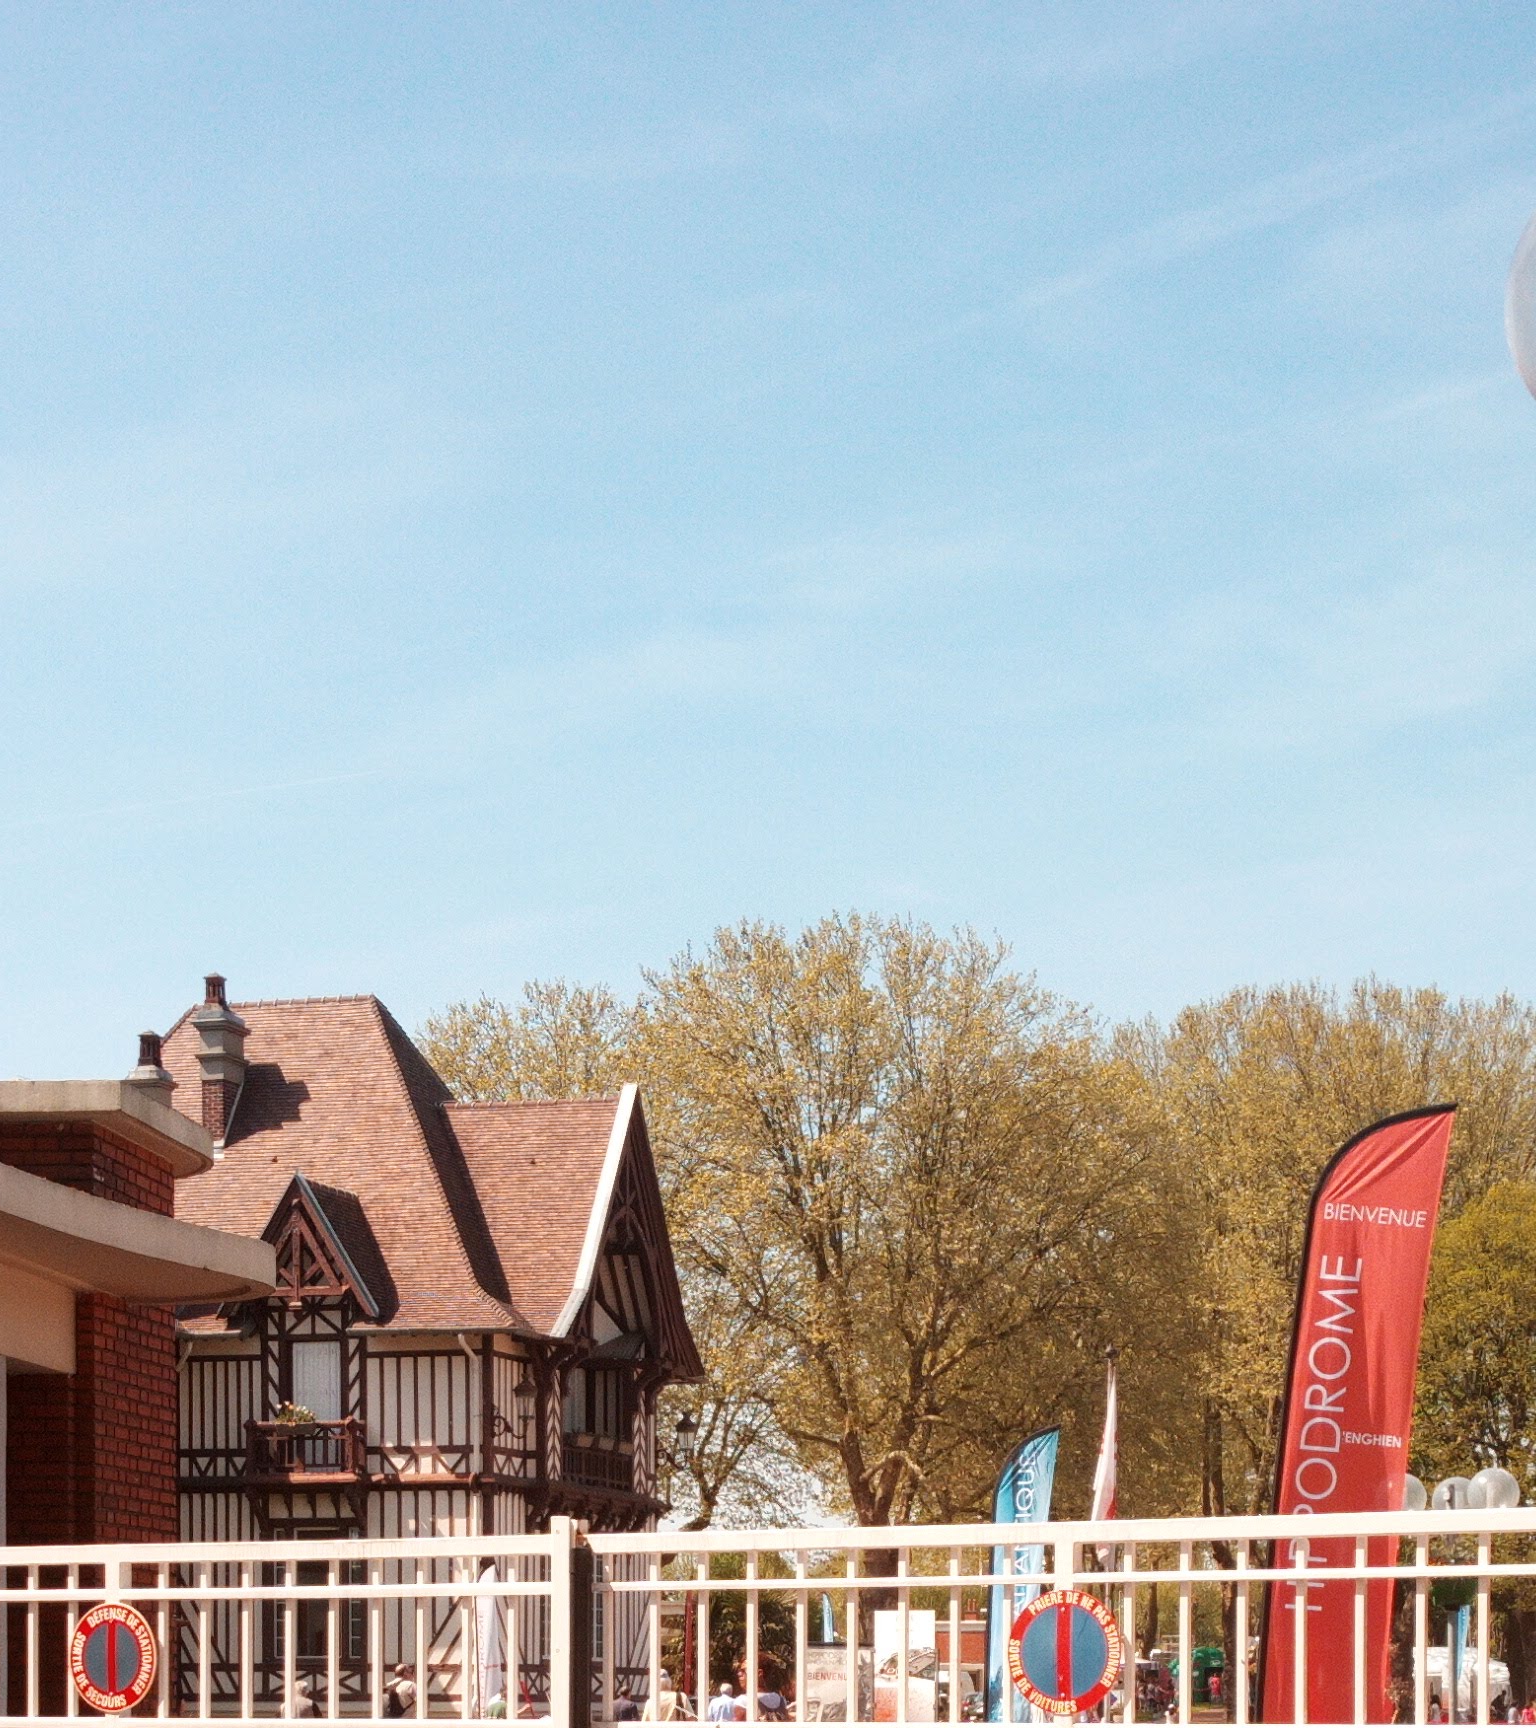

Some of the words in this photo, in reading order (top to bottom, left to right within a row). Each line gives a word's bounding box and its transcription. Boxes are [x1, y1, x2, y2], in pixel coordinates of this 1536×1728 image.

[1323, 1202, 1428, 1229] BIENVENUE
[1065, 1591, 1079, 1605] DE
[1080, 1593, 1095, 1611] NE
[126, 1614, 140, 1630] DE
[1092, 1605, 1111, 1626] PAS
[72, 1631, 86, 1673] SORTIE
[132, 1625, 153, 1695] STATIONNER
[1100, 1624, 1120, 1688] STATIONNER
[75, 1673, 89, 1690] DE
[1008, 1638, 1024, 1679] SORTIE
[1016, 1677, 1032, 1692] DE
[1028, 1688, 1078, 1713] VOITURES
[85, 1686, 127, 1708] SECOURS
